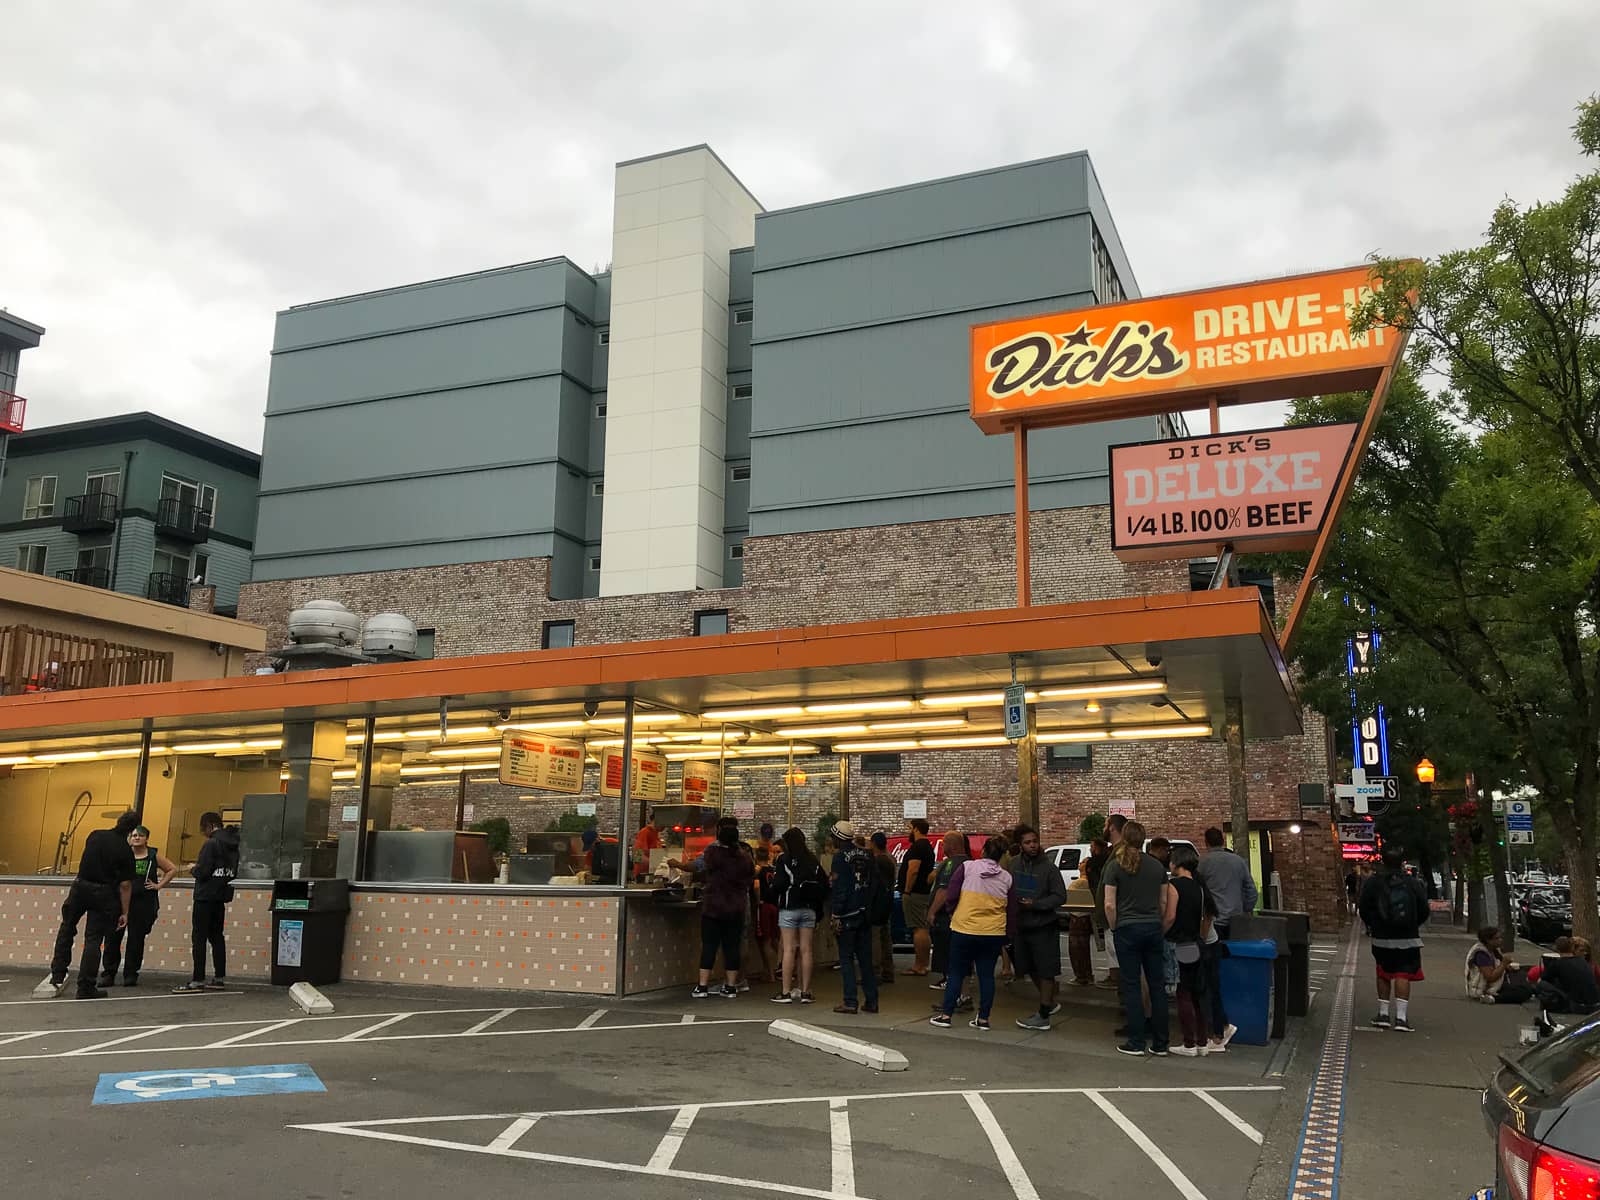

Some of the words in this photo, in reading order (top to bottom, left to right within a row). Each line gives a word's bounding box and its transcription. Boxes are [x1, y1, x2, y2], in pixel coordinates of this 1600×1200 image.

[986, 322, 1186, 396] Dick's
[1195, 325, 1388, 368] RESTAURANT
[1169, 435, 1271, 460] DICK'S
[1123, 451, 1323, 507] DELUXE
[1127, 515, 1158, 537] 1/4
[1162, 512, 1188, 535] LB.
[1192, 507, 1241, 533] 100%
[1246, 501, 1313, 528] BEEF
